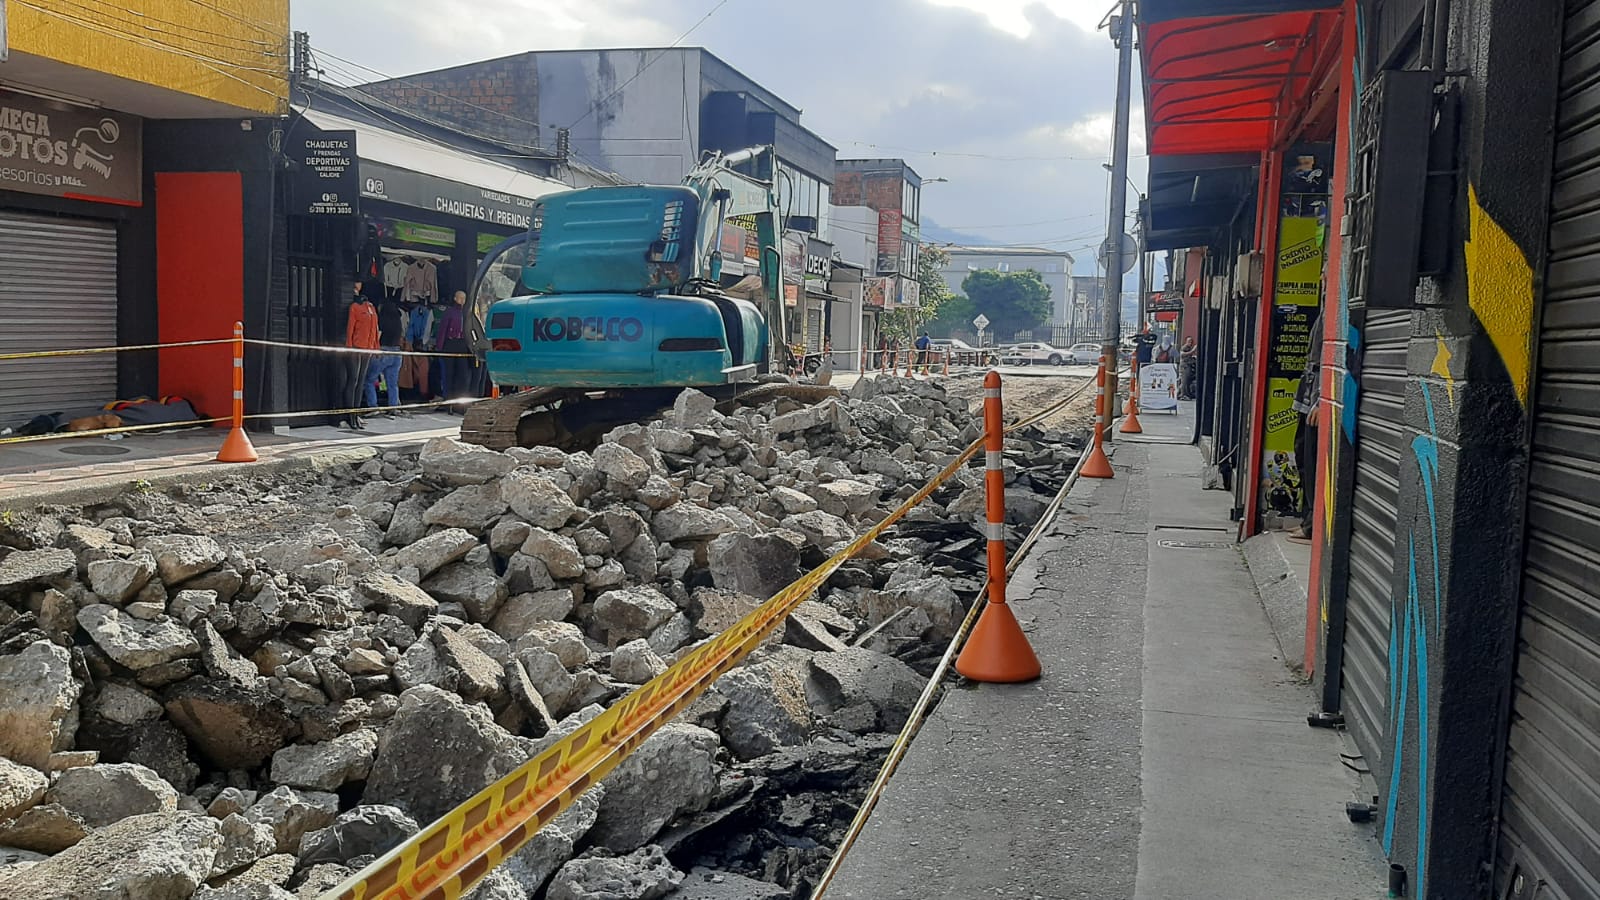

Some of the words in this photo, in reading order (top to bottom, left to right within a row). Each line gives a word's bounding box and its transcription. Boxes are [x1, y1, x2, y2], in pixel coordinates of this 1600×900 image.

[305, 140, 348, 149] CHAQUETAS
[306, 157, 350, 165] DEPORTIVAS
[0, 166, 53, 186] esorios
[481, 189, 512, 204] VARIEDADES
[436, 196, 486, 220] CHAQUETAS
[488, 208, 495, 222] Y
[497, 210, 531, 228] PRENDAS
[1280, 250, 1319, 269] INMEDIATO
[533, 316, 643, 342] KOBELCO
